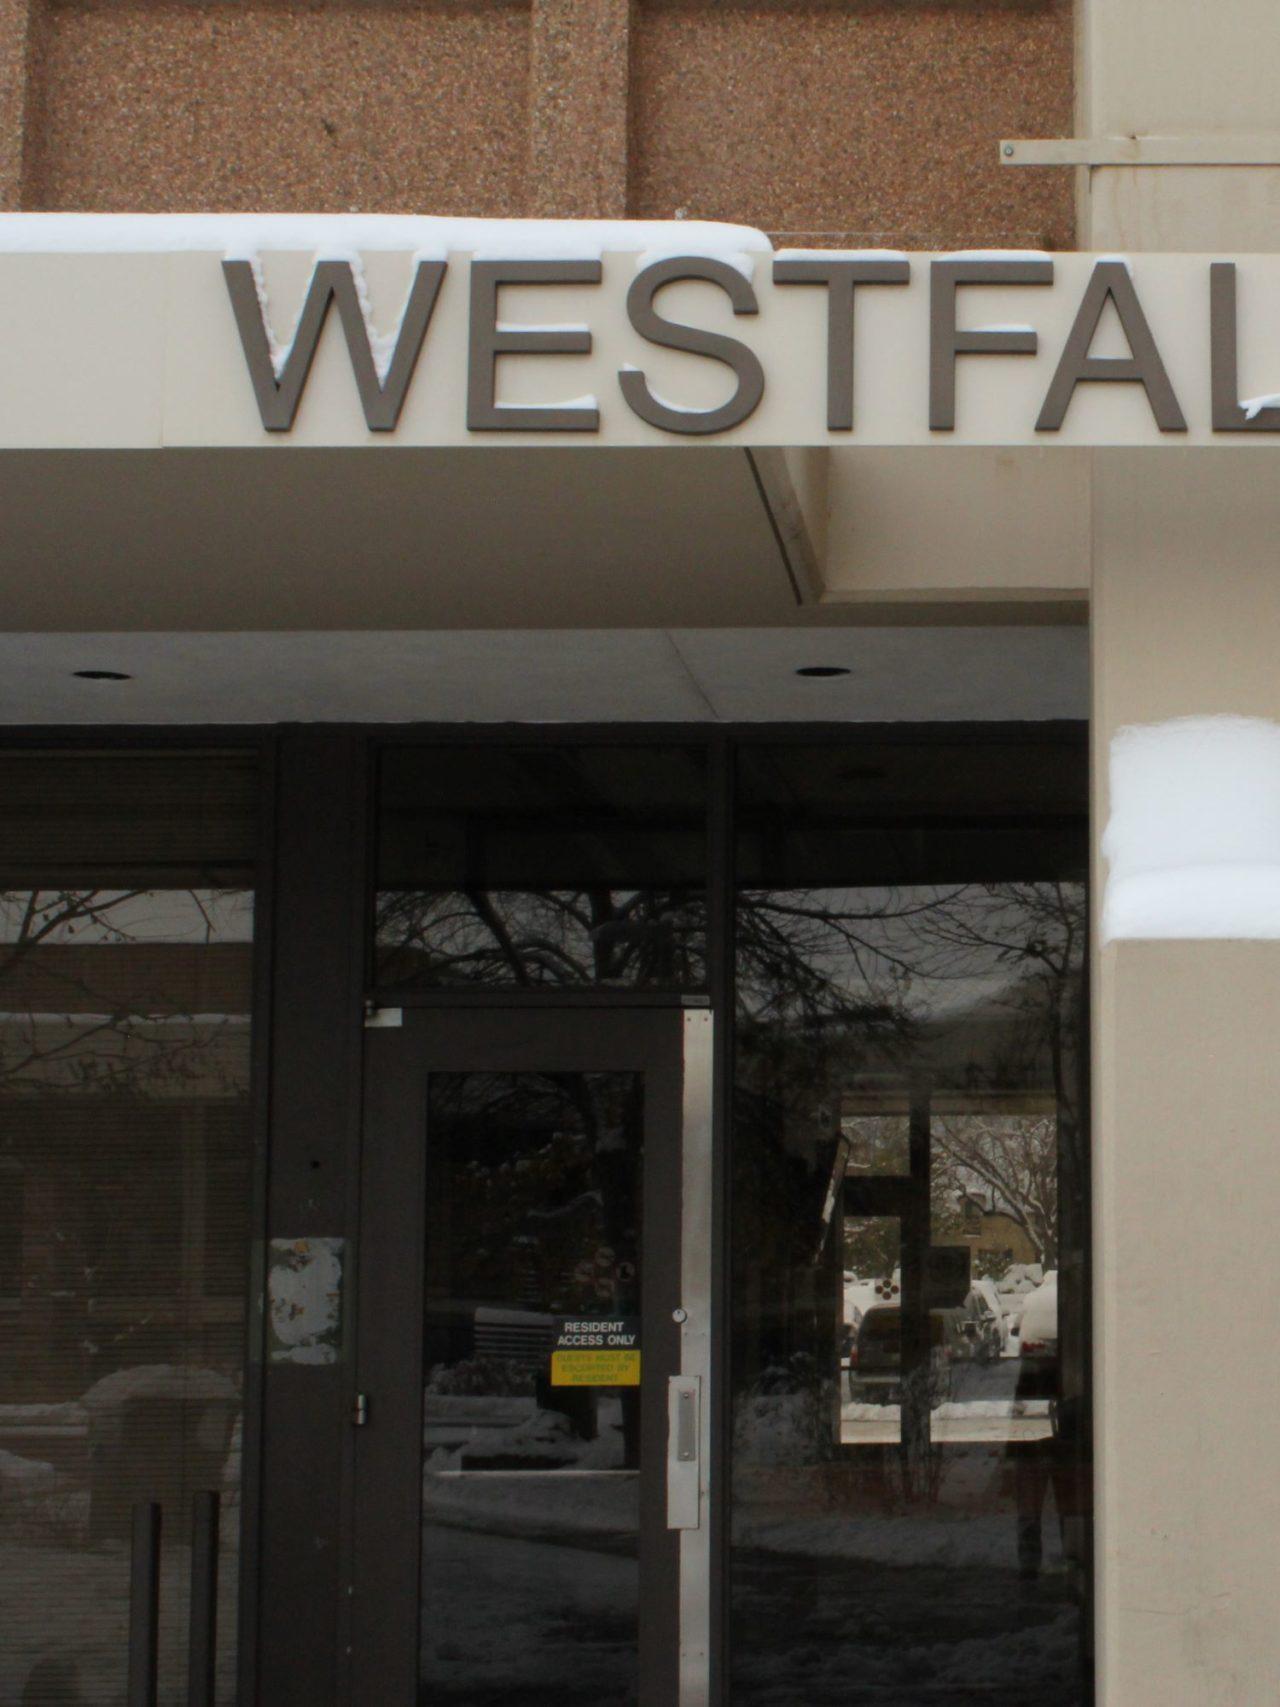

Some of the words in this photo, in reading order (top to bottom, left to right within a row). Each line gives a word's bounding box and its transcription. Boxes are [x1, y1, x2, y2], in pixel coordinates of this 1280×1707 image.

[564, 1322, 624, 1332] RESIDENT
[558, 1335, 604, 1345] ACCESS
[607, 1335, 636, 1345] ONLY
